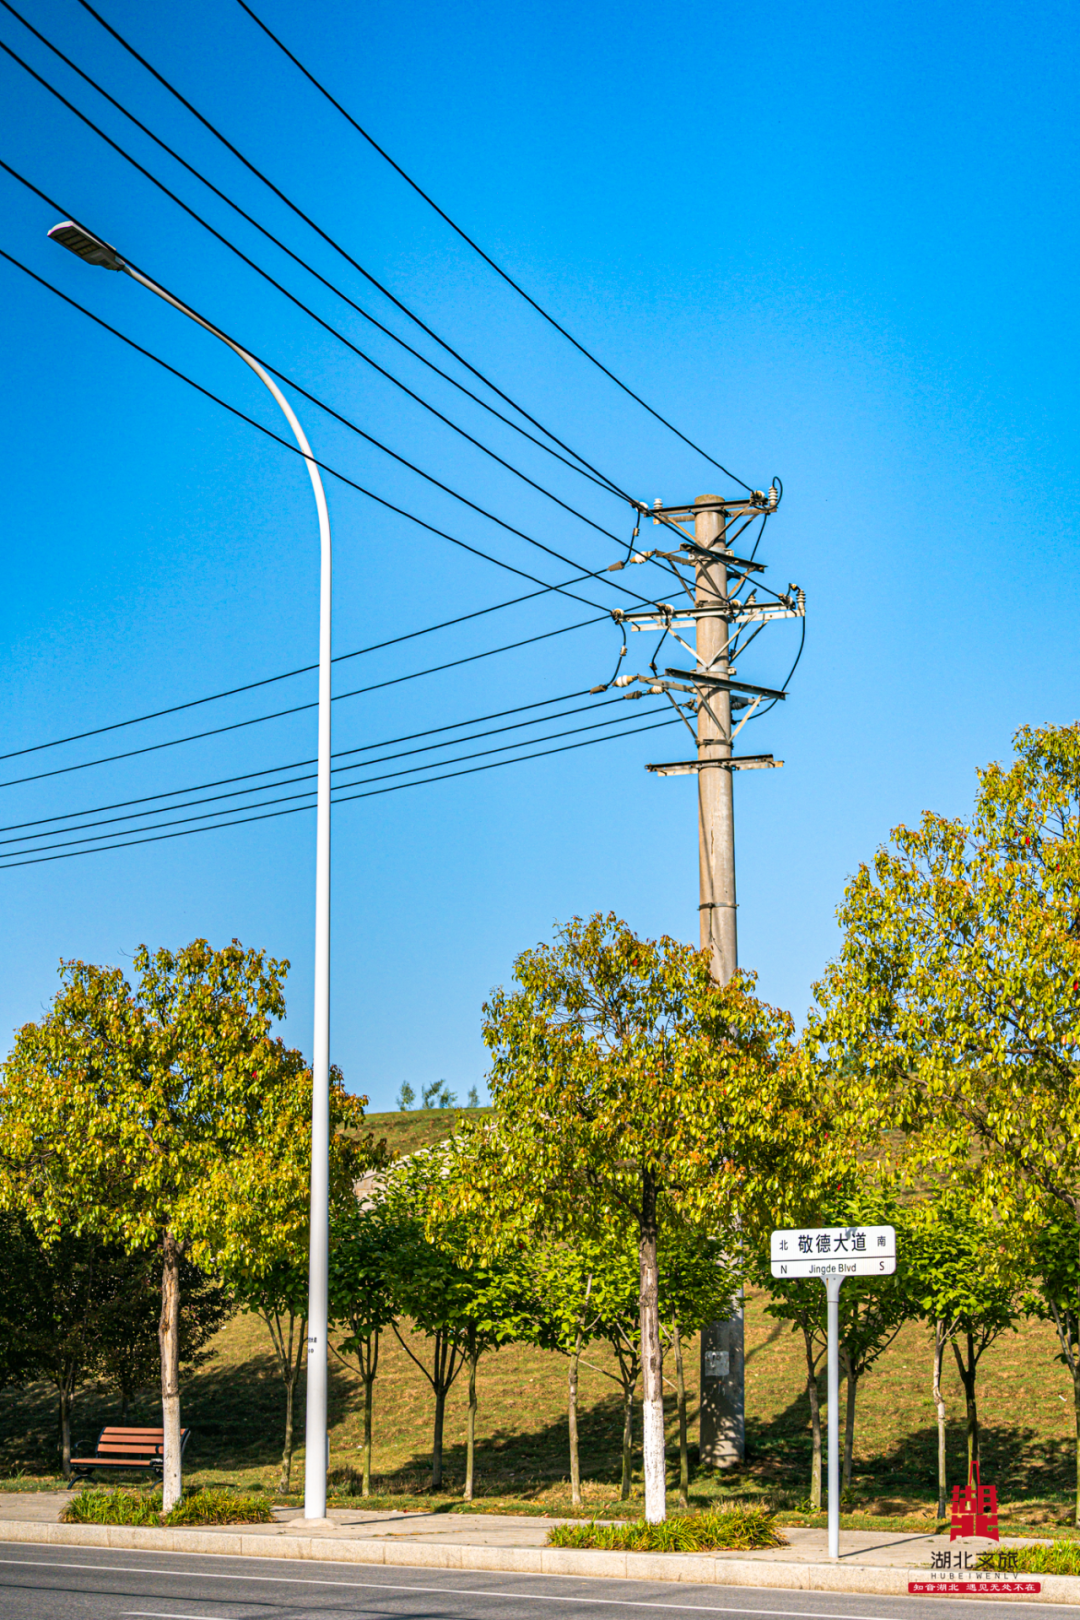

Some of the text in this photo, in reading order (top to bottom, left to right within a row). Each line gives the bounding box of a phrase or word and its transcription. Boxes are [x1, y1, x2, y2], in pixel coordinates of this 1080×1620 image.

[779, 1232, 887, 1254] 北 敬德大道 南
[780, 1261, 885, 1275] N Jingde Blvd S
